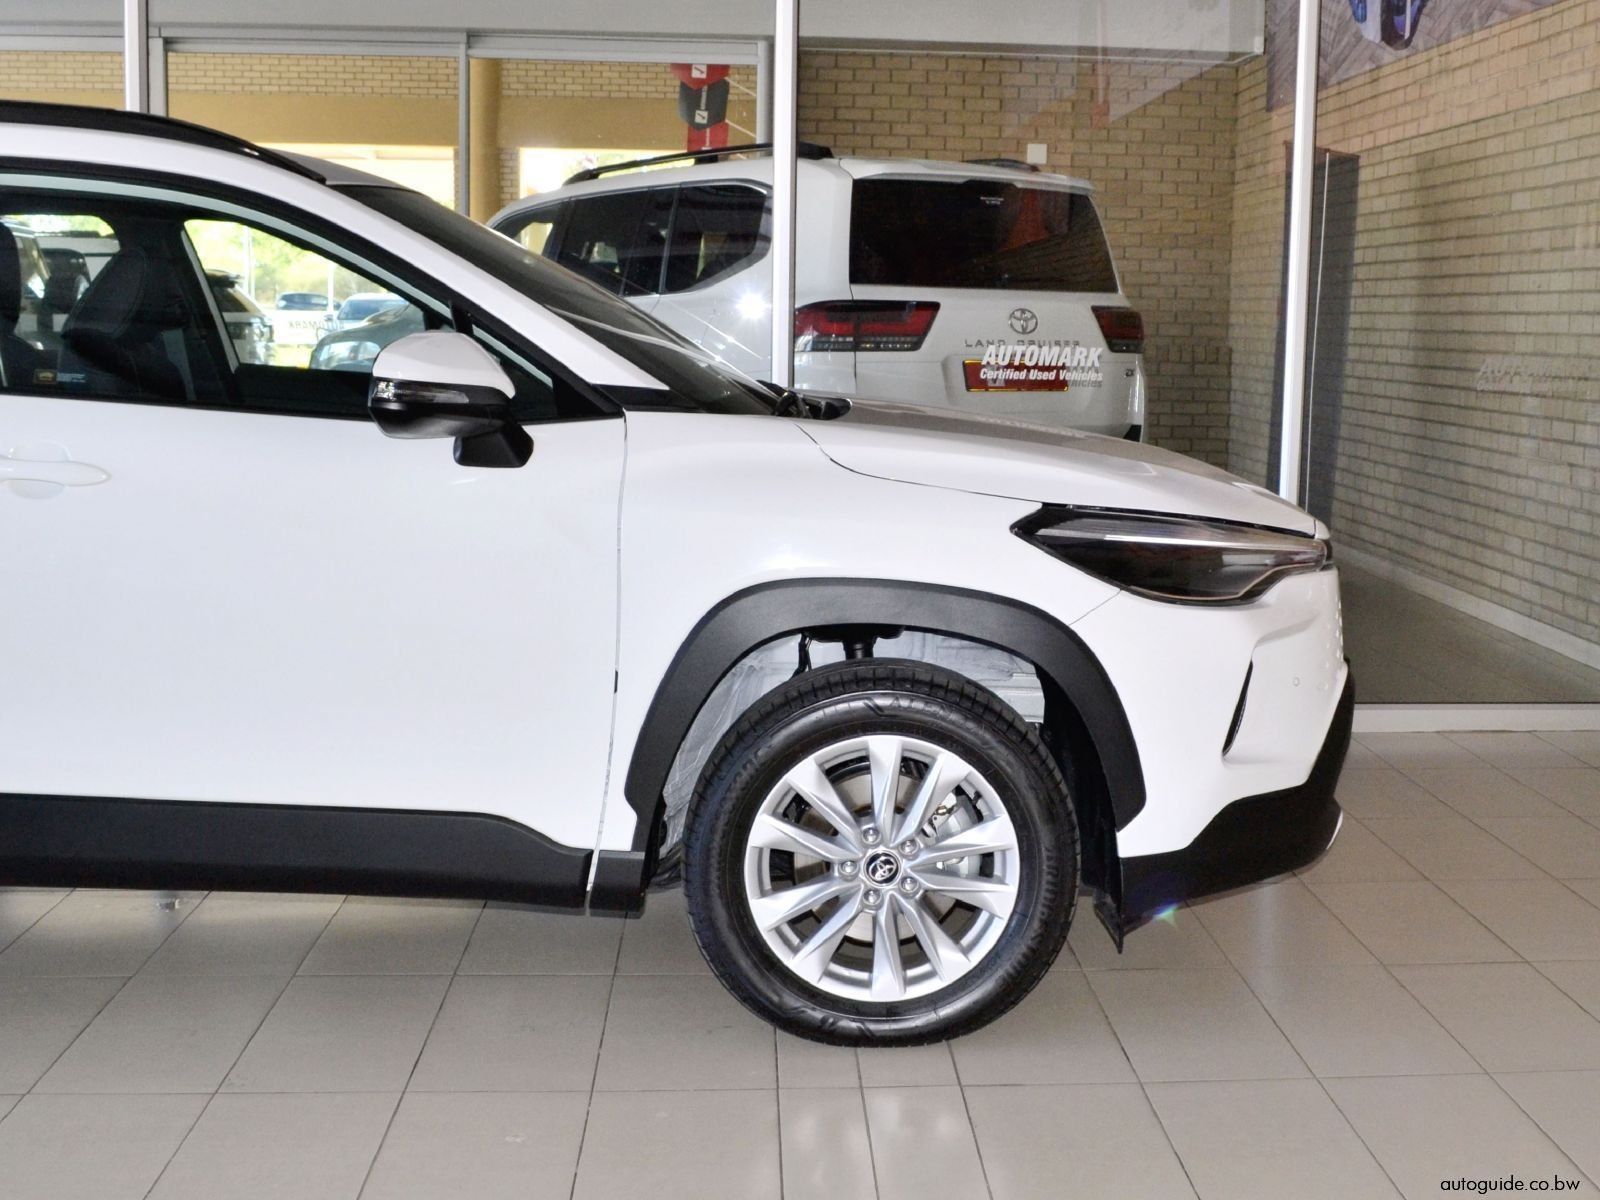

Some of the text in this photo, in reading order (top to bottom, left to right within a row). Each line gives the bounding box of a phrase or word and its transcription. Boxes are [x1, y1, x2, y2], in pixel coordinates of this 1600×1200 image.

[964, 339, 1006, 349] LAND
[981, 345, 1103, 368] AUTOMARK
[980, 368, 1104, 381] Certified Used Vehicles
